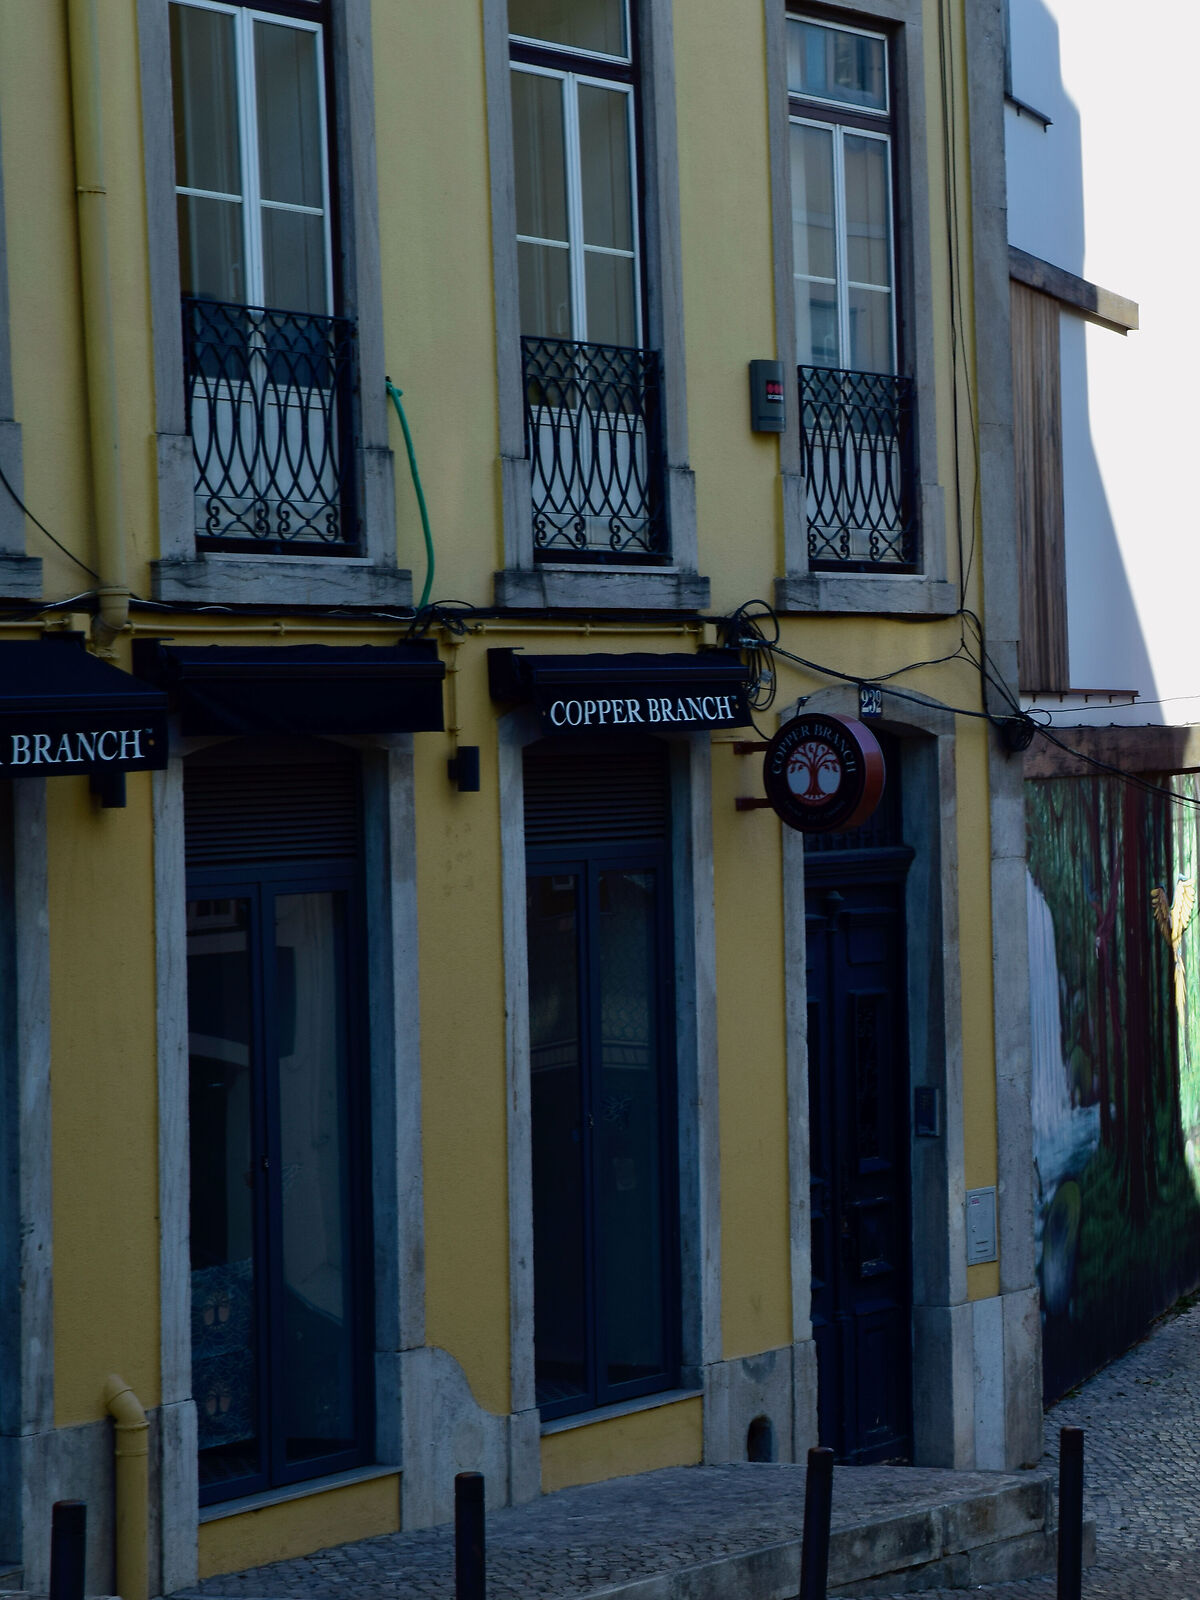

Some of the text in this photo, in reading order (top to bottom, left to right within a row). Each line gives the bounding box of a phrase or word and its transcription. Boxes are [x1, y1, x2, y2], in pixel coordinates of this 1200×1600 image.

[550, 695, 735, 726] COPPER BRANCH
[10, 729, 146, 765] BRANCH
[770, 723, 857, 775] COPPER BRANCH
